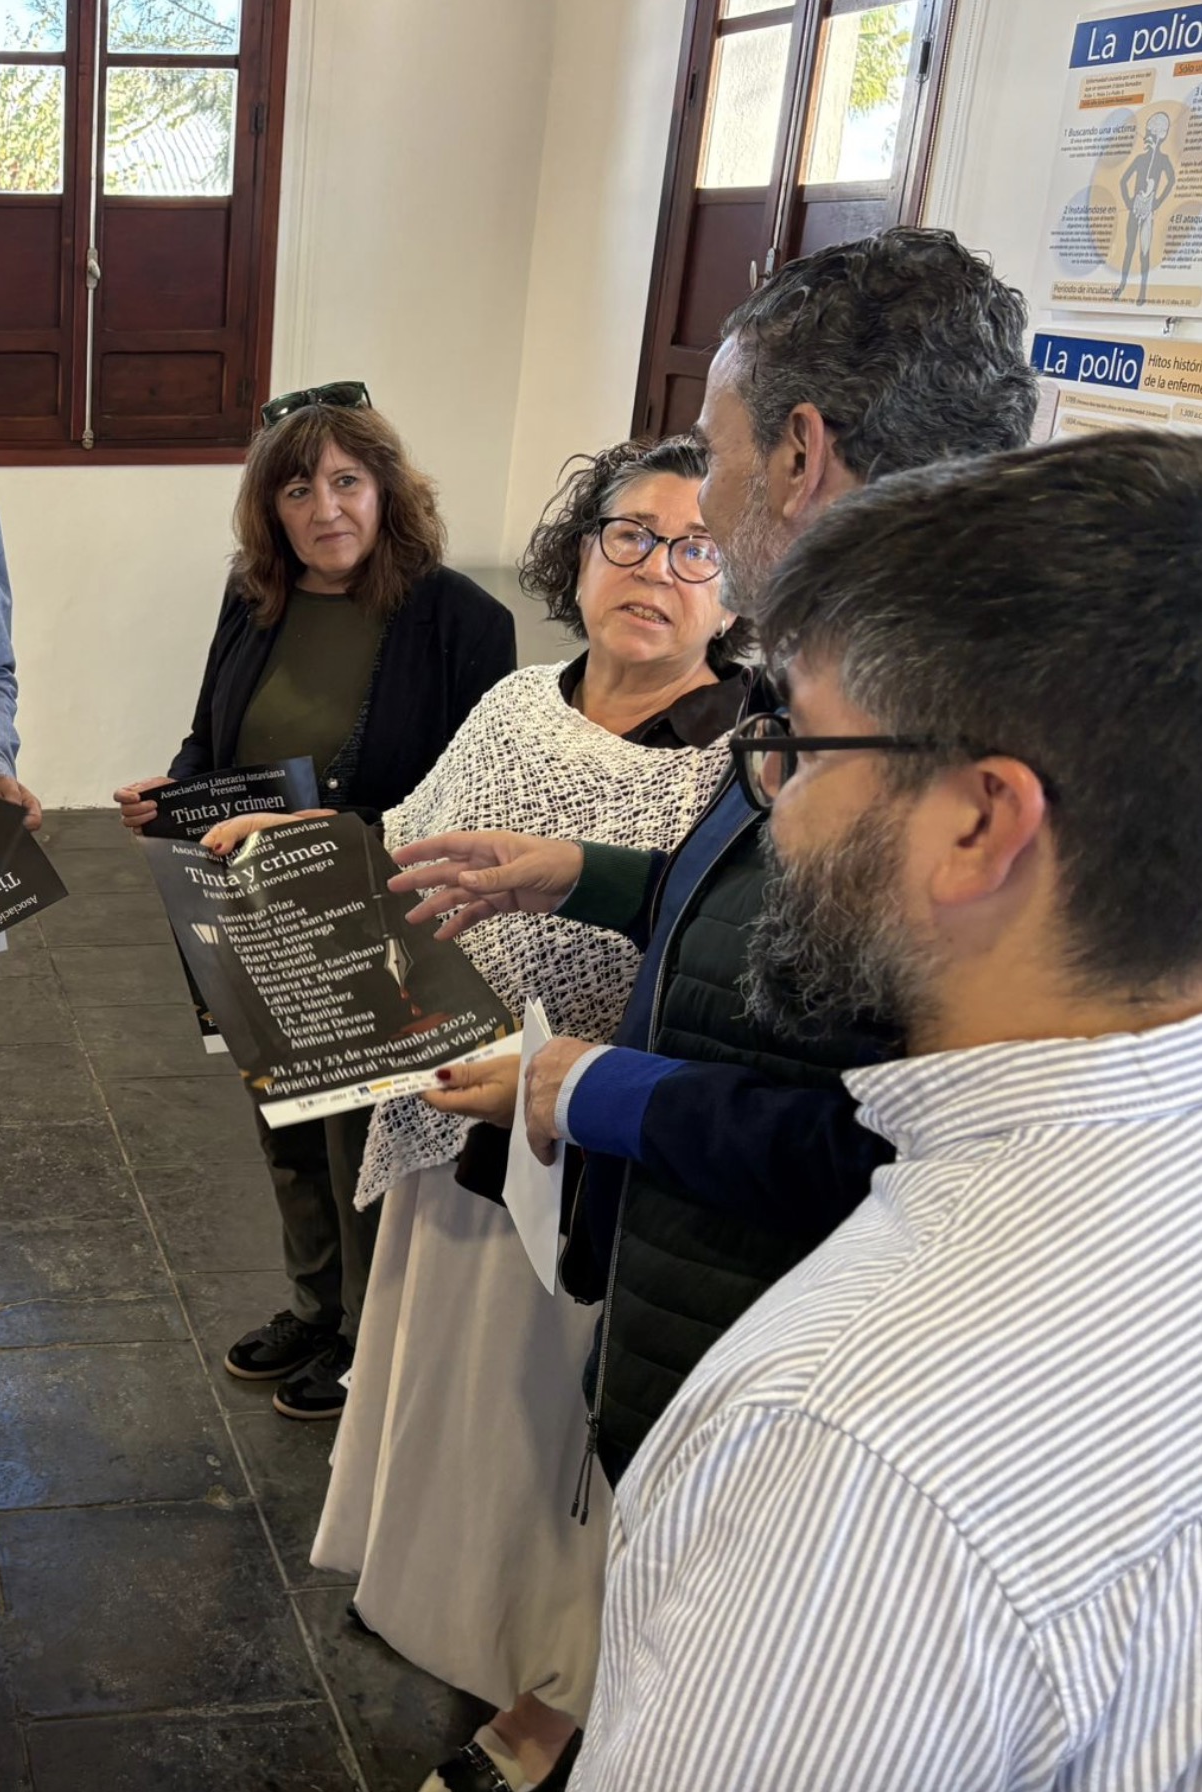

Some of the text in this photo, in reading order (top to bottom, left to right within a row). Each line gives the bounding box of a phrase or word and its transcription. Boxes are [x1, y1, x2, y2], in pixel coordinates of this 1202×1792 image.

[1087, 13, 1202, 62] La polio
[1068, 126, 1099, 137] Buscando
[1043, 341, 1138, 383] La polio
[1148, 354, 1171, 369] Hitos
[1144, 374, 1156, 387] de
[1158, 375, 1166, 389] la
[160, 769, 286, 800] Asociación Literaria Antaviana
[209, 783, 247, 797] Presenta
[170, 795, 286, 824] Tinta y crimen
[272, 821, 330, 843] Antaviana
[184, 866, 241, 888] Tinta
[241, 865, 255, 884] y
[260, 840, 339, 872] crimen
[202, 858, 335, 900] Festival de novela negra
[217, 899, 296, 924] Santiago Díaz
[228, 901, 366, 944] Manuel Ríos San Martín
[248, 919, 272, 931] Lier
[273, 907, 308, 925] Horst
[233, 923, 335, 954] Carmen Amoraga
[239, 942, 314, 965] Maxi Roldán
[245, 951, 317, 975] Paz Castelló
[251, 944, 385, 985] Paco Gómez Escribano
[257, 980, 302, 996] Susana
[316, 960, 373, 984] Miguelez
[263, 984, 332, 1007] Laia Tinaut
[270, 991, 354, 1016] Chus Sánchez
[281, 1011, 375, 1038] Vicenta Devesa
[300, 1006, 343, 1024] Aguilar
[290, 1023, 375, 1050] Ainhoa Pastor
[292, 1060, 312, 1073] 22
[312, 1059, 322, 1072] y
[323, 1054, 343, 1067] 23
[344, 1049, 362, 1062] de
[363, 1028, 439, 1057] noviembre
[440, 1010, 477, 1033] 2025
[264, 1074, 320, 1096] Espacio
[322, 1059, 379, 1083] cultural
